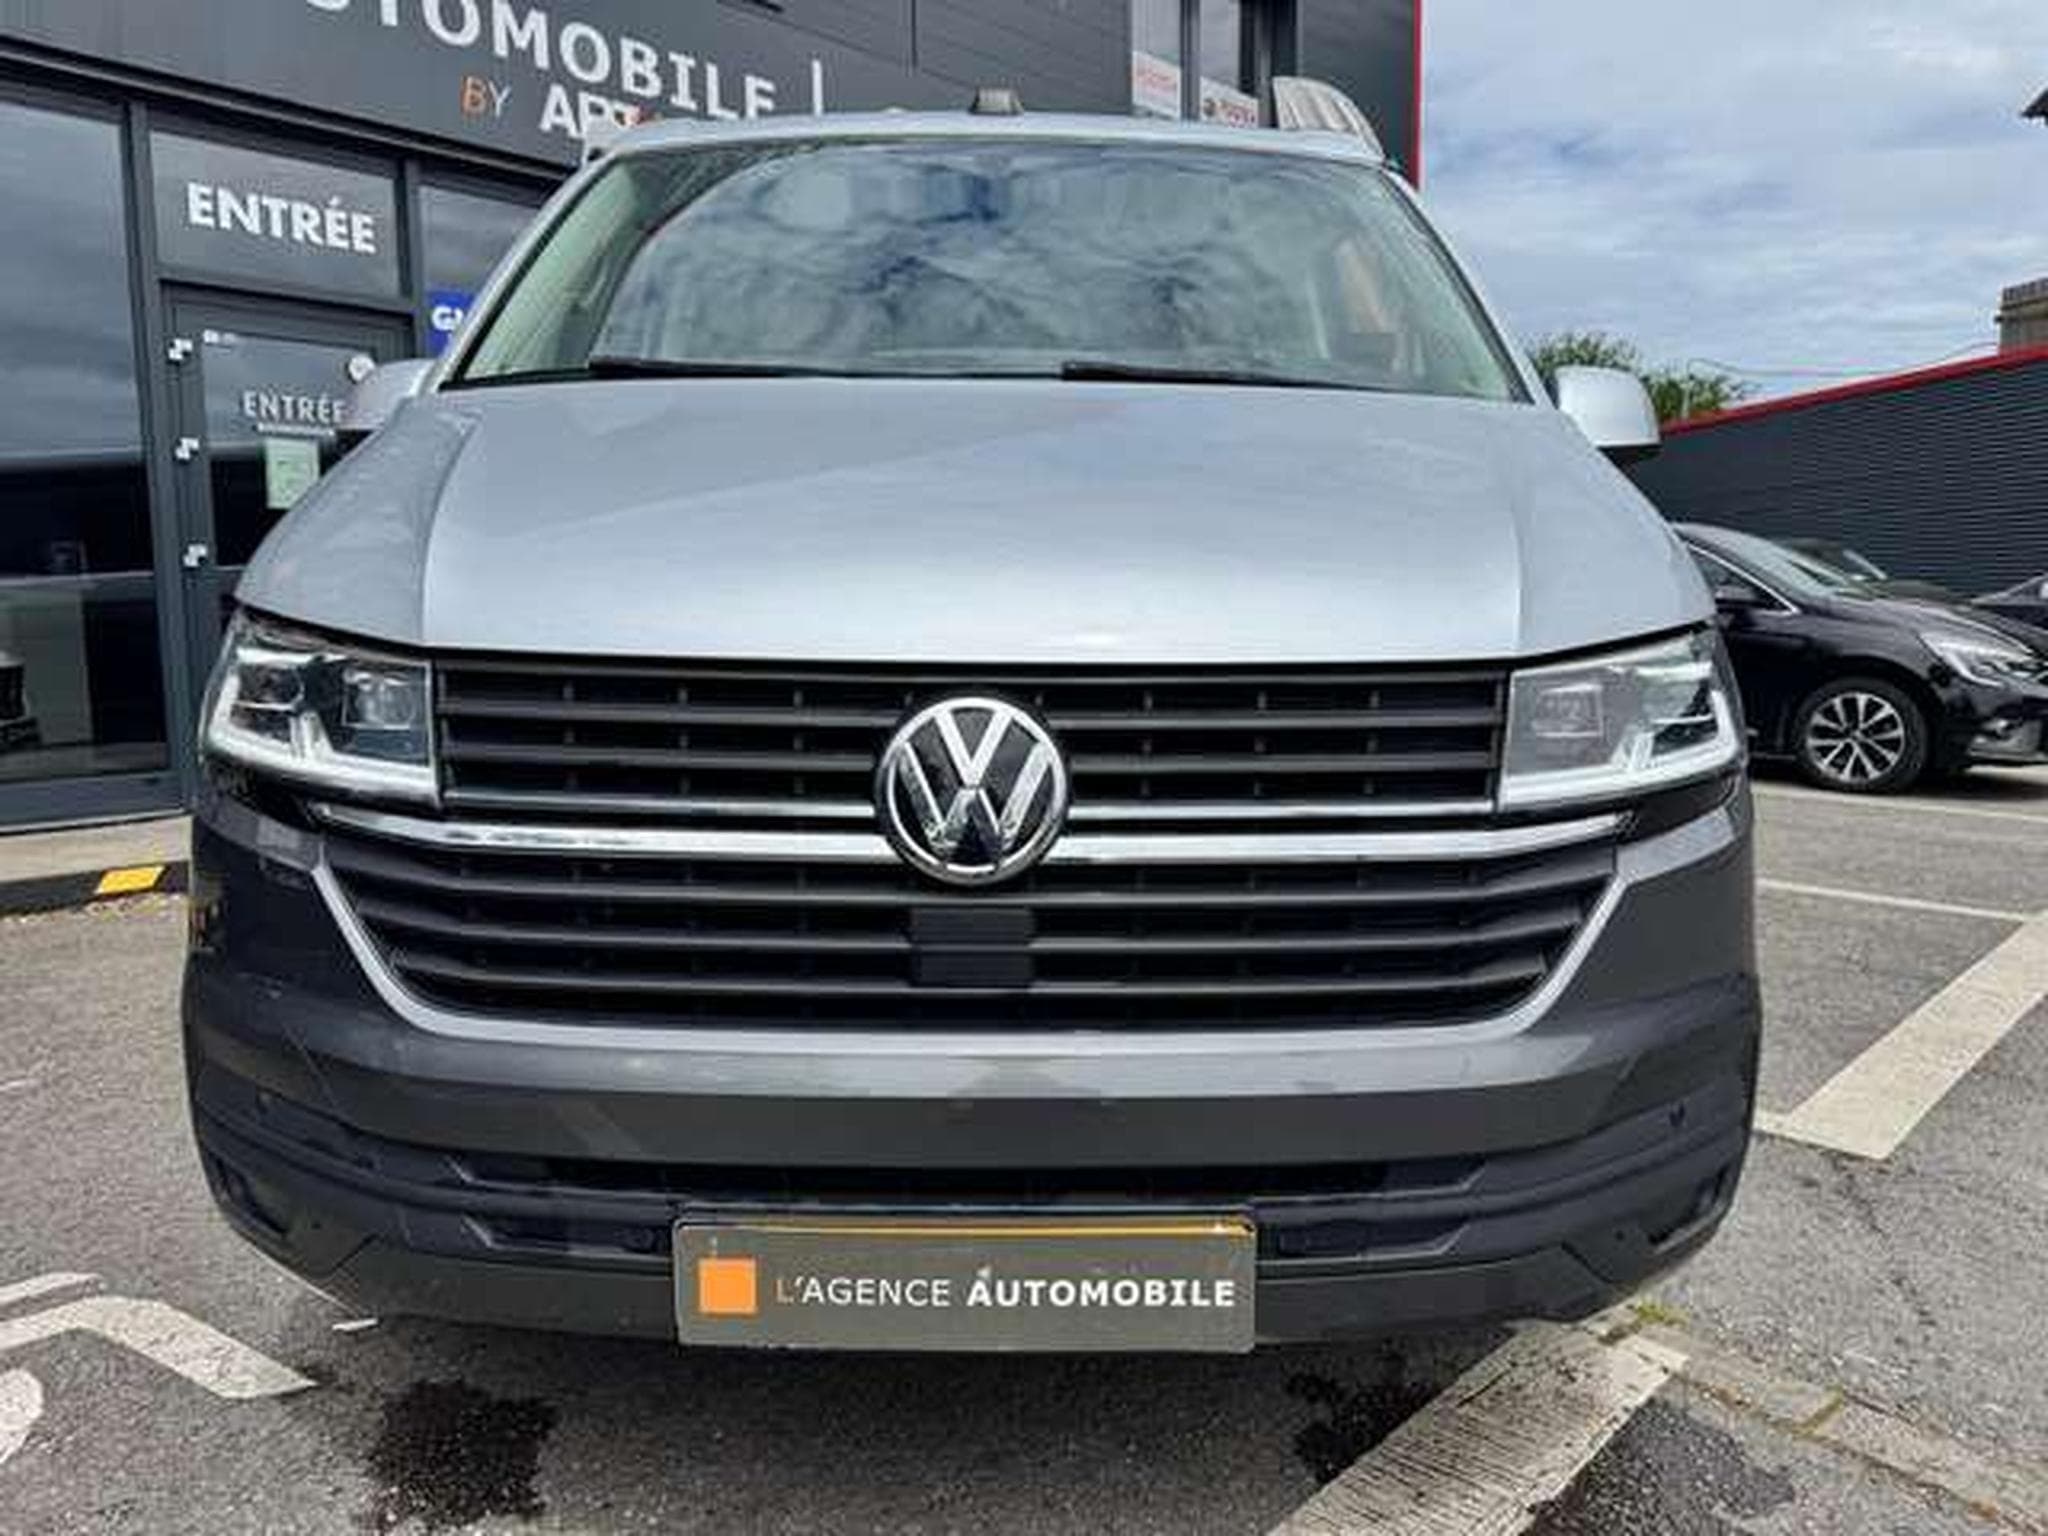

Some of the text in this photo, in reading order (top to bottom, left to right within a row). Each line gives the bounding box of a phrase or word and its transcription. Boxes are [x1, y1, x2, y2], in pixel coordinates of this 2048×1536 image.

[460, 75, 512, 119] BY
[186, 182, 376, 254] ENTRÉE
[775, 1276, 1235, 1307] L'AGENCE AUTOMOBILE
